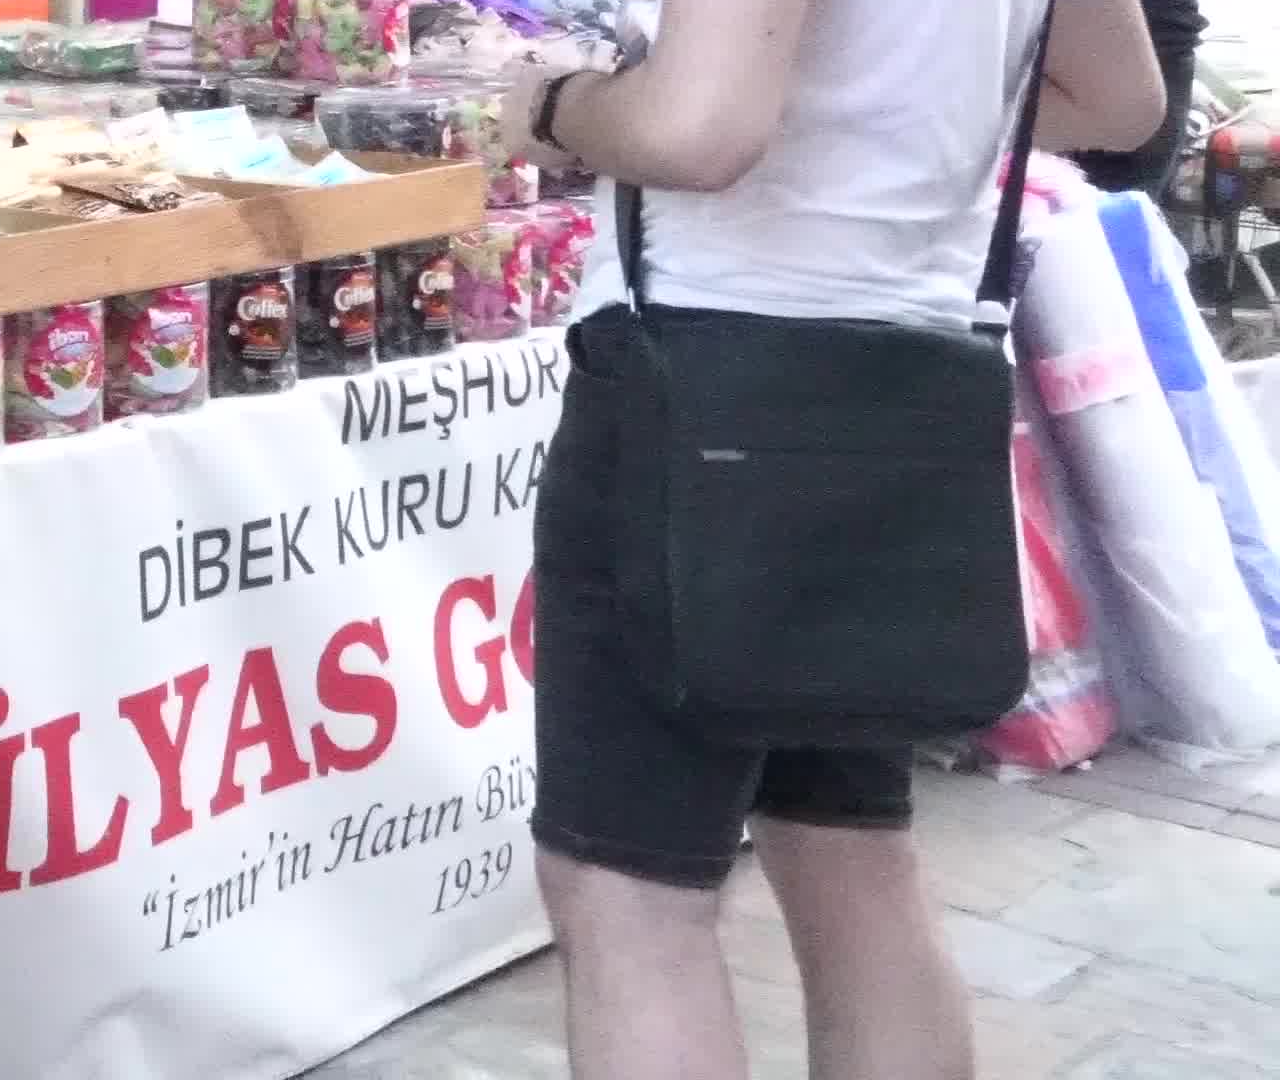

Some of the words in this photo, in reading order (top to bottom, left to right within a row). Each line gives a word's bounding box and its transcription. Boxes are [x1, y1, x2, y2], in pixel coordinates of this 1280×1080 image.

[342, 345, 561, 446] MEŞHUR
[140, 506, 315, 623] DİBEK
[334, 462, 472, 565] KURU
[431, 840, 513, 916] 1939
